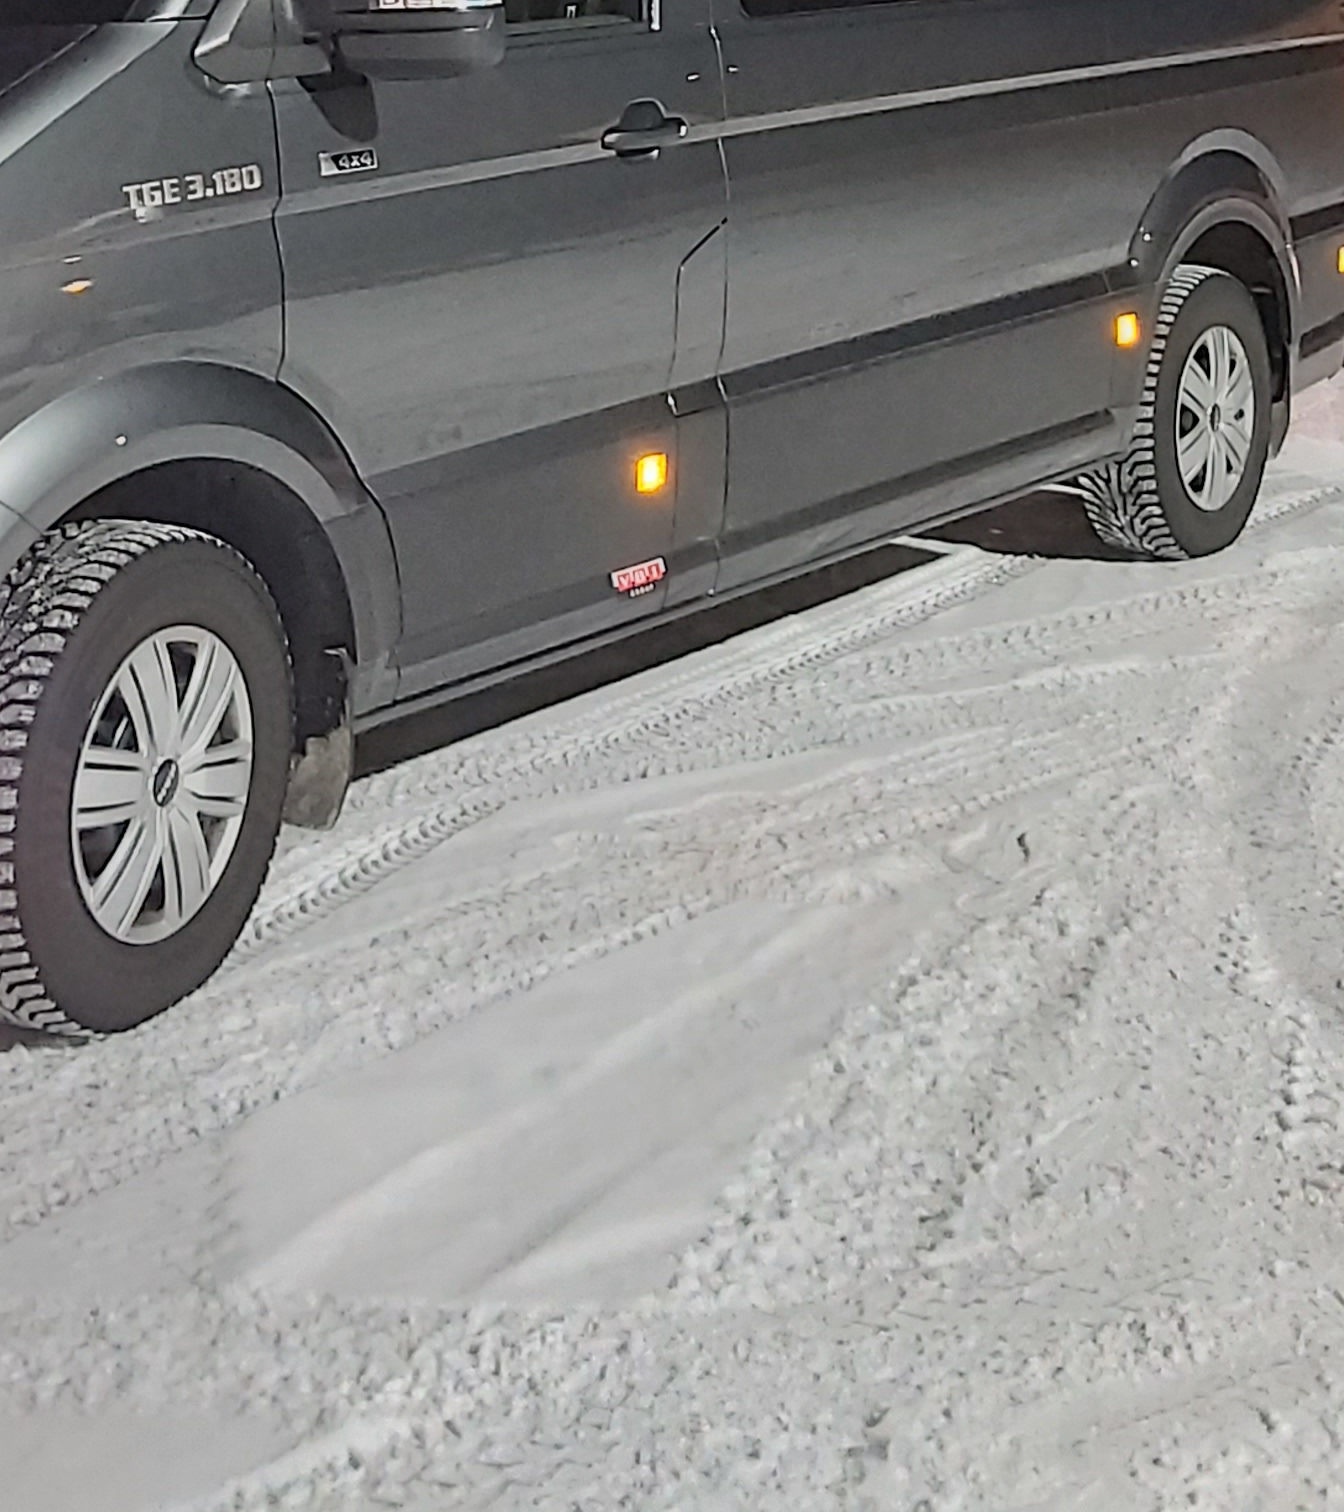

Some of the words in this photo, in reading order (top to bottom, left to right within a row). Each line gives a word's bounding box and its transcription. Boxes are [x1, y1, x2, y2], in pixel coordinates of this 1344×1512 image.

[338, 151, 373, 169] 4x4
[122, 178, 182, 211] TGE
[184, 164, 263, 201] 3.180
